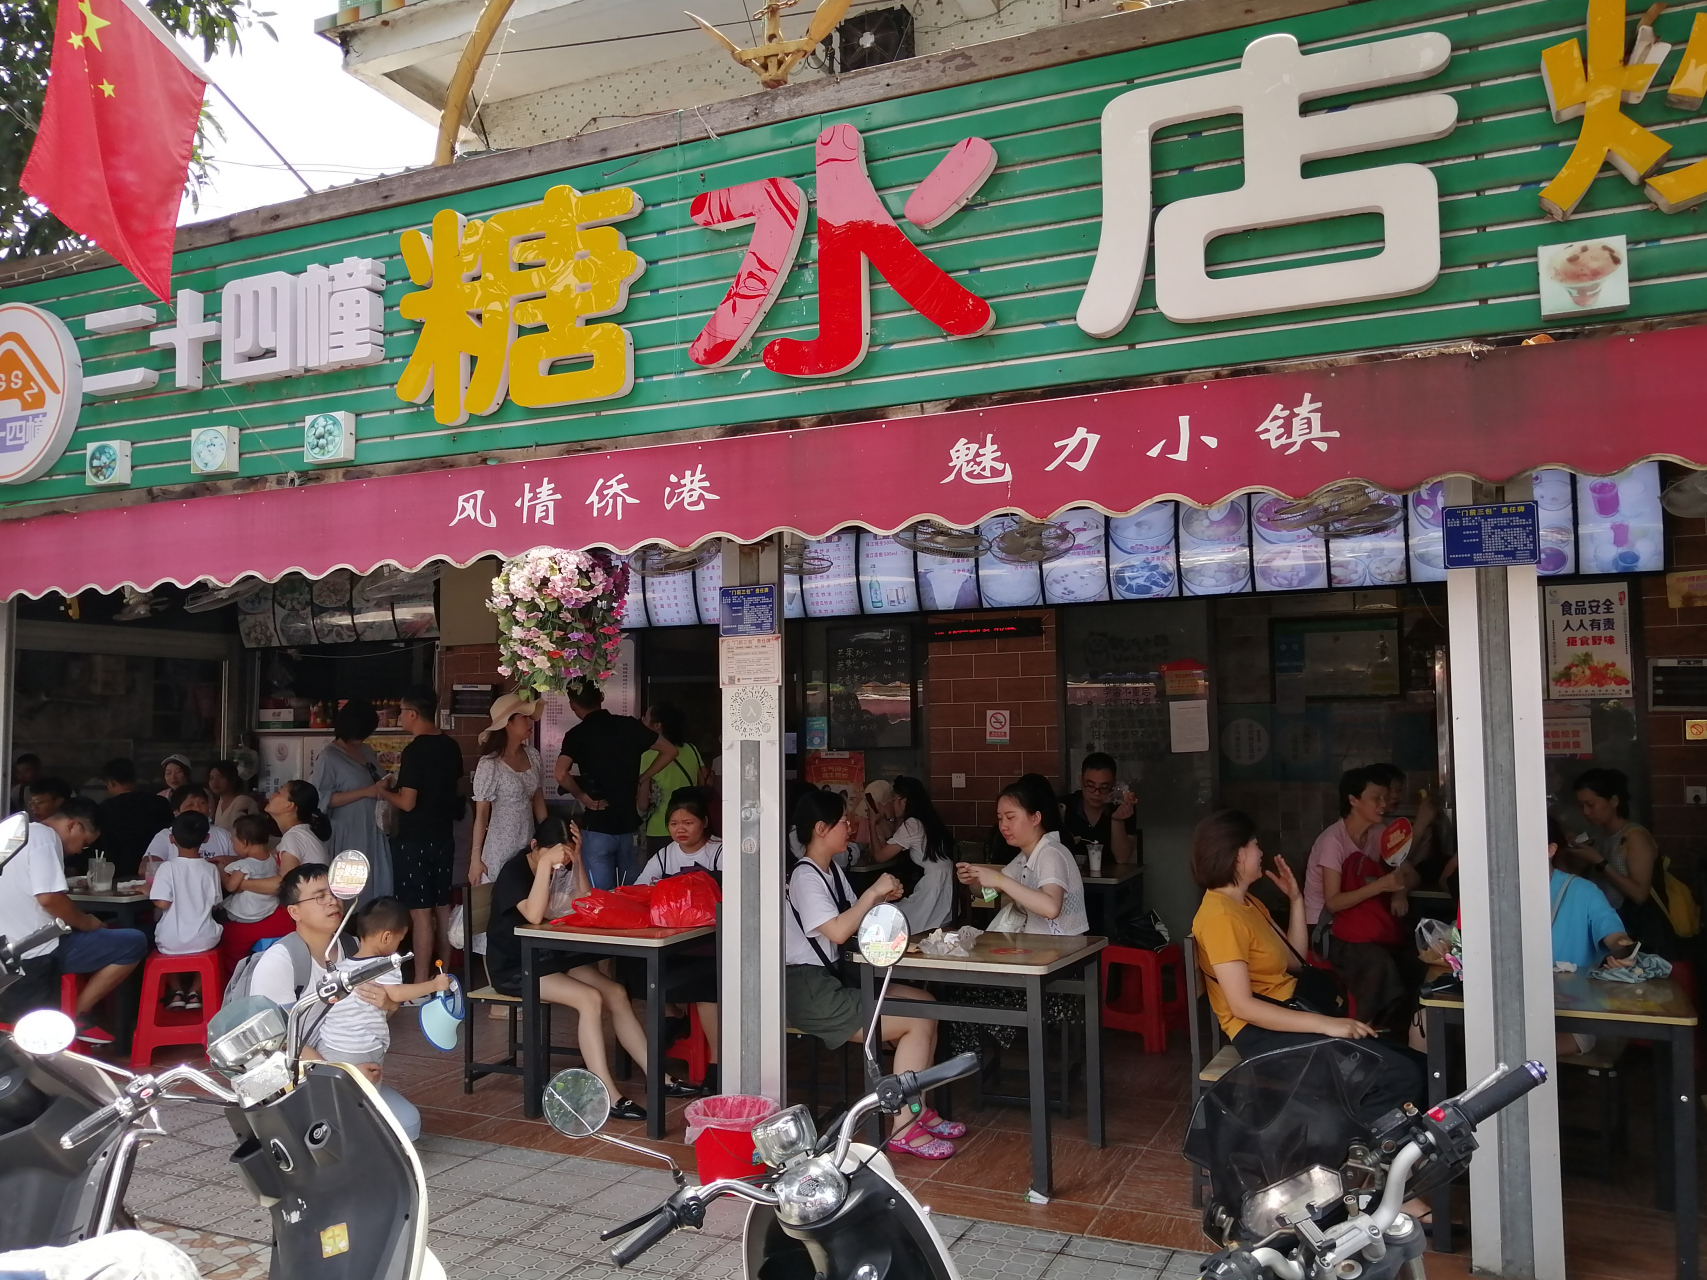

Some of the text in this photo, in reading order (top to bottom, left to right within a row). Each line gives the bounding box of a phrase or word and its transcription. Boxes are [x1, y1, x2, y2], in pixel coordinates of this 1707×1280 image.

[395, 33, 1459, 426] 糖水店
[83, 256, 387, 396] 二十四幢
[940, 393, 1340, 484] 魅力小镇
[449, 464, 721, 528] 风情侨港
[1560, 598, 1615, 616] 食品安全
[1562, 617, 1616, 632] 人人有责
[1566, 635, 1616, 647] 拒食野味
